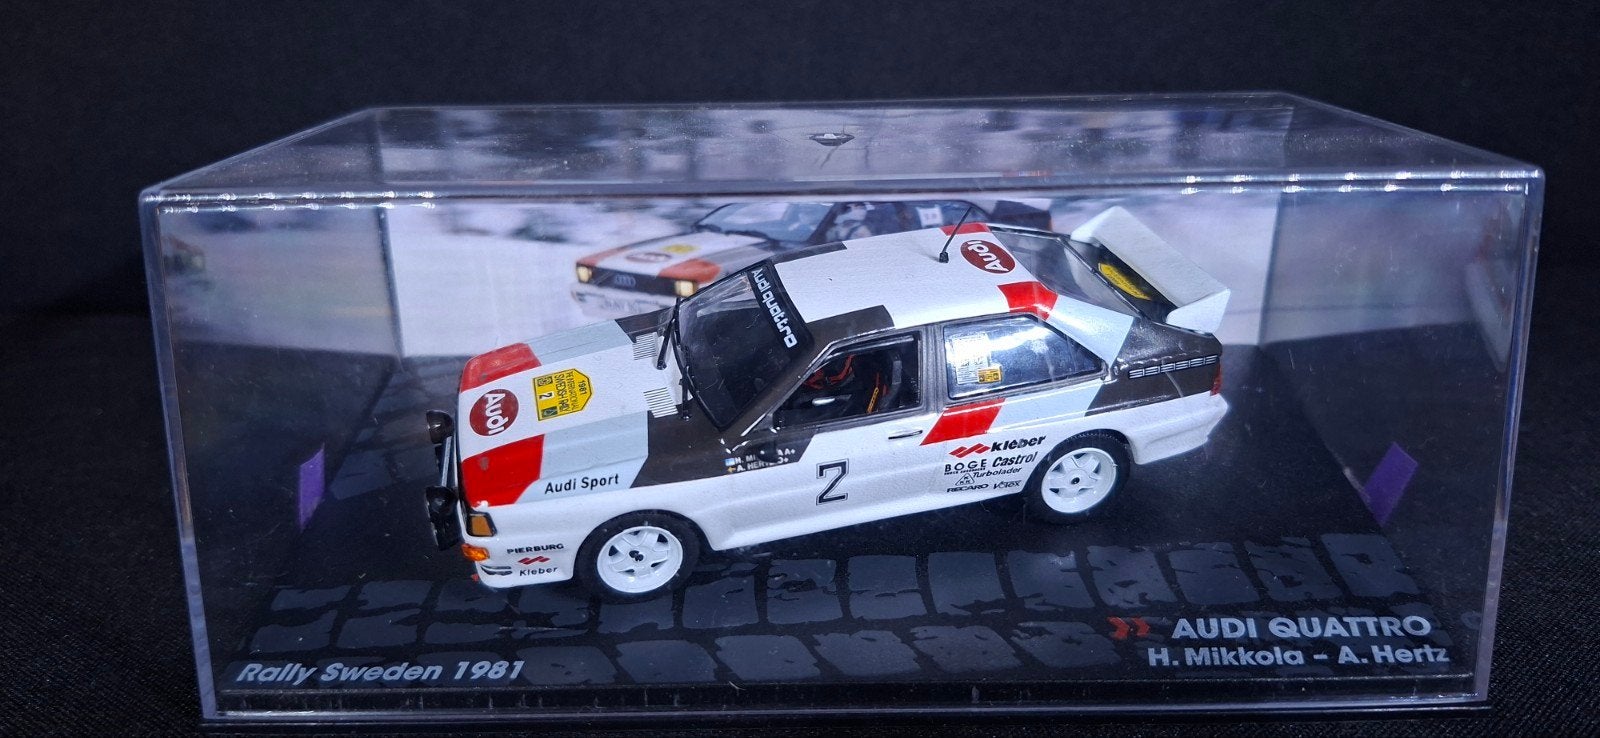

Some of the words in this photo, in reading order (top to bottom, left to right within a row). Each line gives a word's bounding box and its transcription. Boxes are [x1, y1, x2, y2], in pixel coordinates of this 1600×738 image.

[966, 239, 1009, 272] Audi
[751, 268, 770, 293] Audi
[763, 291, 798, 349] quattro
[578, 380, 587, 395] 1981
[484, 393, 509, 435] Audi
[944, 459, 987, 472] BOGE
[992, 451, 1038, 467] Castrol
[815, 457, 849, 506] 2
[973, 467, 1022, 478] Turbolader
[544, 478, 577, 495] Audi
[580, 473, 620, 490] Sport
[946, 483, 989, 493] RECARO
[506, 543, 565, 554] PIERBURG
[1171, 617, 1258, 639] AUDI
[1268, 614, 1432, 638] QUATTRO
[1147, 646, 1180, 667] H.
[1184, 645, 1305, 667] Mikkola
[1337, 644, 1369, 665] A.
[1372, 644, 1451, 664] Hertz
[235, 662, 317, 687] Rally
[320, 661, 443, 682] Sweden
[452, 660, 525, 680] 1981
